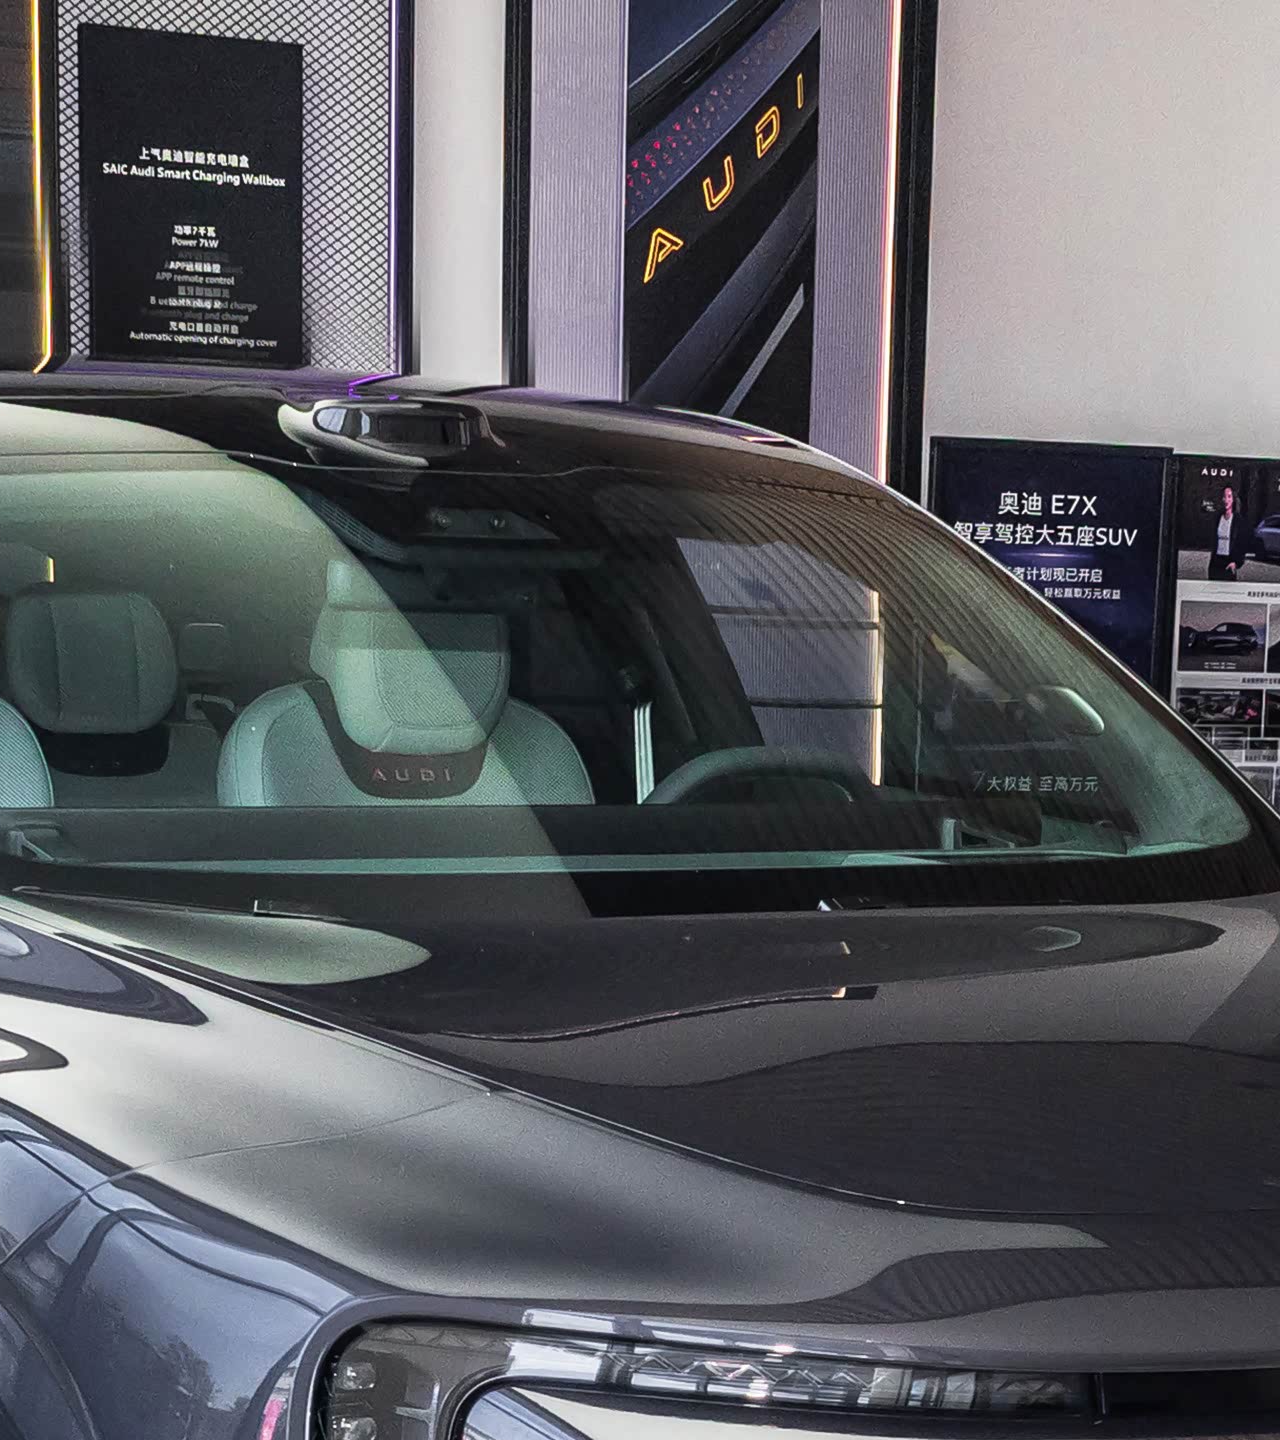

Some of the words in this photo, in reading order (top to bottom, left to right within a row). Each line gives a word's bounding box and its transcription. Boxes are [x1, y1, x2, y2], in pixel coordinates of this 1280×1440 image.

[102, 162, 128, 176] SAIC
[130, 165, 155, 178] Audi
[157, 167, 191, 181] Smart
[192, 170, 241, 187] Charging
[242, 173, 286, 188] Wallbox
[643, 72, 804, 284] AUDI
[171, 236, 198, 248] Power
[173, 273, 204, 284] remote
[205, 275, 235, 286] control
[129, 330, 173, 342] Automatic
[173, 334, 208, 345] opening
[208, 335, 218, 344] of
[219, 336, 255, 348] charging
[256, 339, 279, 348] cover
[1201, 468, 1234, 478] AUDI
[997, 491, 1043, 516] 奥迪
[1051, 494, 1098, 516] E7X
[953, 520, 1138, 547] 智享驾控大五座SUV
[1007, 567, 1103, 584] 者计划现已开启
[371, 767, 451, 783] AUDI
[1038, 775, 1099, 793] 至高万元
